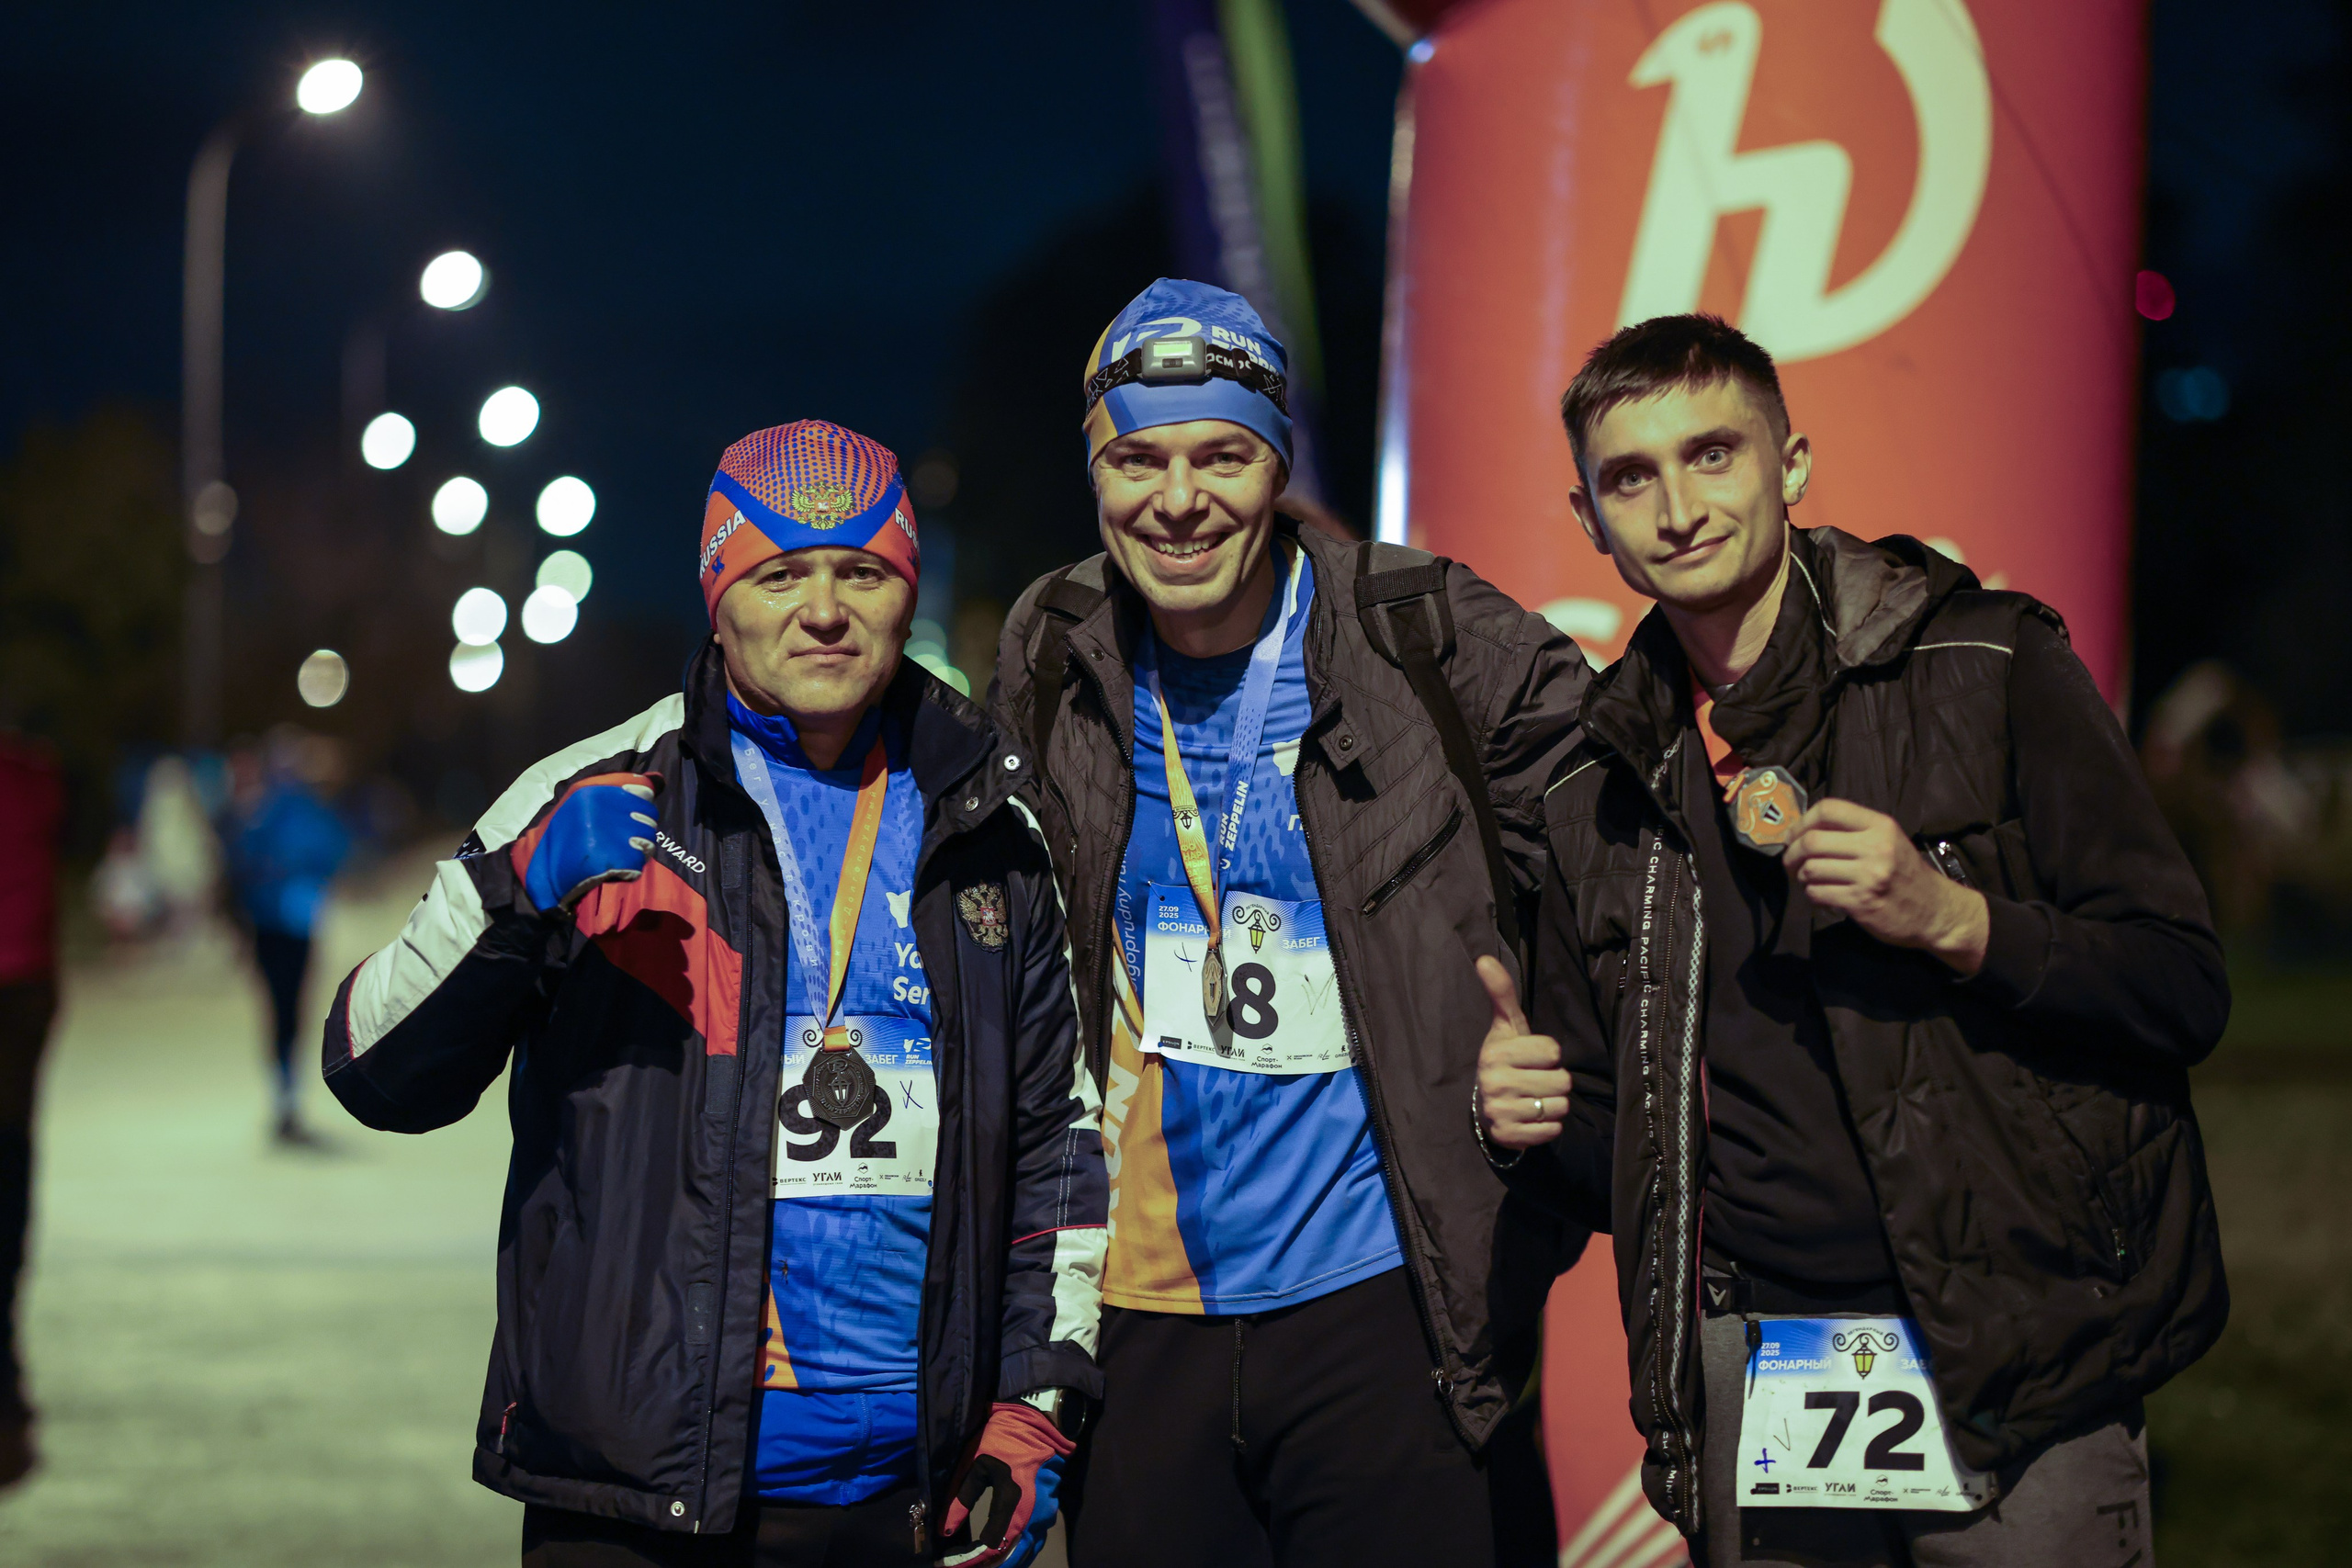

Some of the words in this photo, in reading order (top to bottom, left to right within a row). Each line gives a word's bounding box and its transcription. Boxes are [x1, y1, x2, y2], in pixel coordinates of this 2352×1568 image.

[1211, 325, 1261, 355] RUN
[699, 509, 746, 579] RUSSIA
[895, 507, 920, 553] RUS
[1220, 812, 1229, 845] RUN
[1226, 780, 1249, 852] ZEPPELIN
[744, 747, 762, 783] Бег
[792, 899, 819, 967] крови
[1642, 856, 1659, 931] CHARMING
[1283, 937, 1320, 950] ЗАБЕГ
[1640, 937, 1652, 993] PACIFIC
[1227, 962, 1279, 1040] 8
[865, 1054, 898, 1065] ЗАБЕГ
[1220, 1045, 1245, 1057] УГЛИ
[1640, 998, 1650, 1076] CHARMING
[778, 1083, 898, 1162] 92
[812, 1171, 842, 1182] УГЛИ
[1758, 1358, 1832, 1371] ФОНАРНЫЙ
[1804, 1390, 1925, 1472] 72
[1825, 1482, 1856, 1492] УГЛИ
